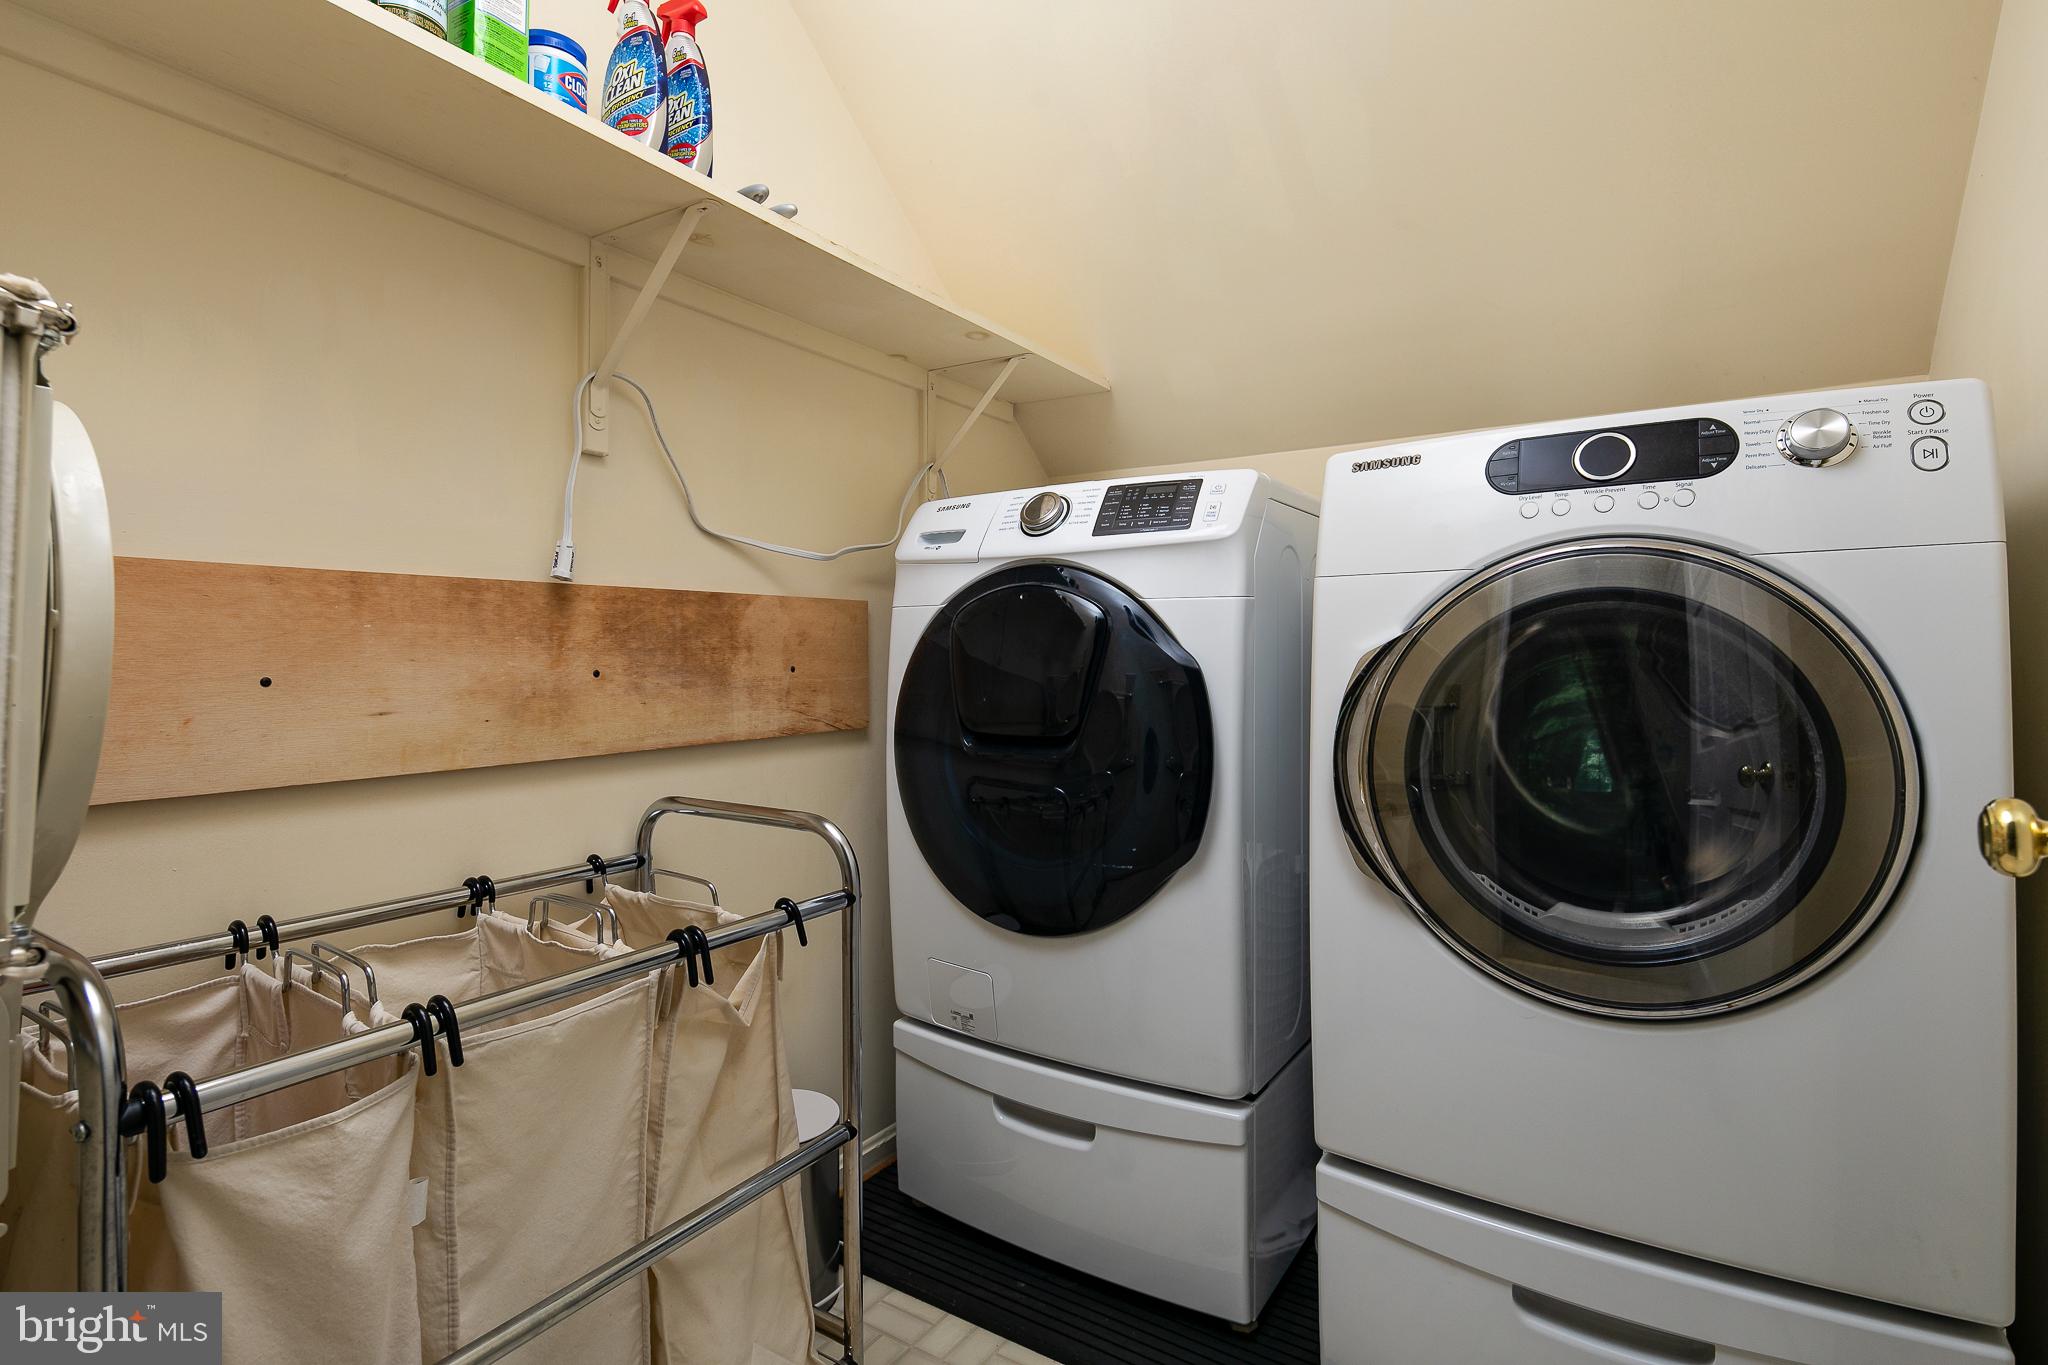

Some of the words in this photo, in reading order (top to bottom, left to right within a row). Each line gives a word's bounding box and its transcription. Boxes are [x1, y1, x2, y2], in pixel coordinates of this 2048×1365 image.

[612, 61, 636, 87] OXI
[564, 75, 587, 101] CLOR
[604, 70, 643, 108] CLEAN
[668, 101, 693, 125] EAN
[1352, 454, 1422, 473] SAMSUNG
[936, 502, 972, 512] SAMSUNG
